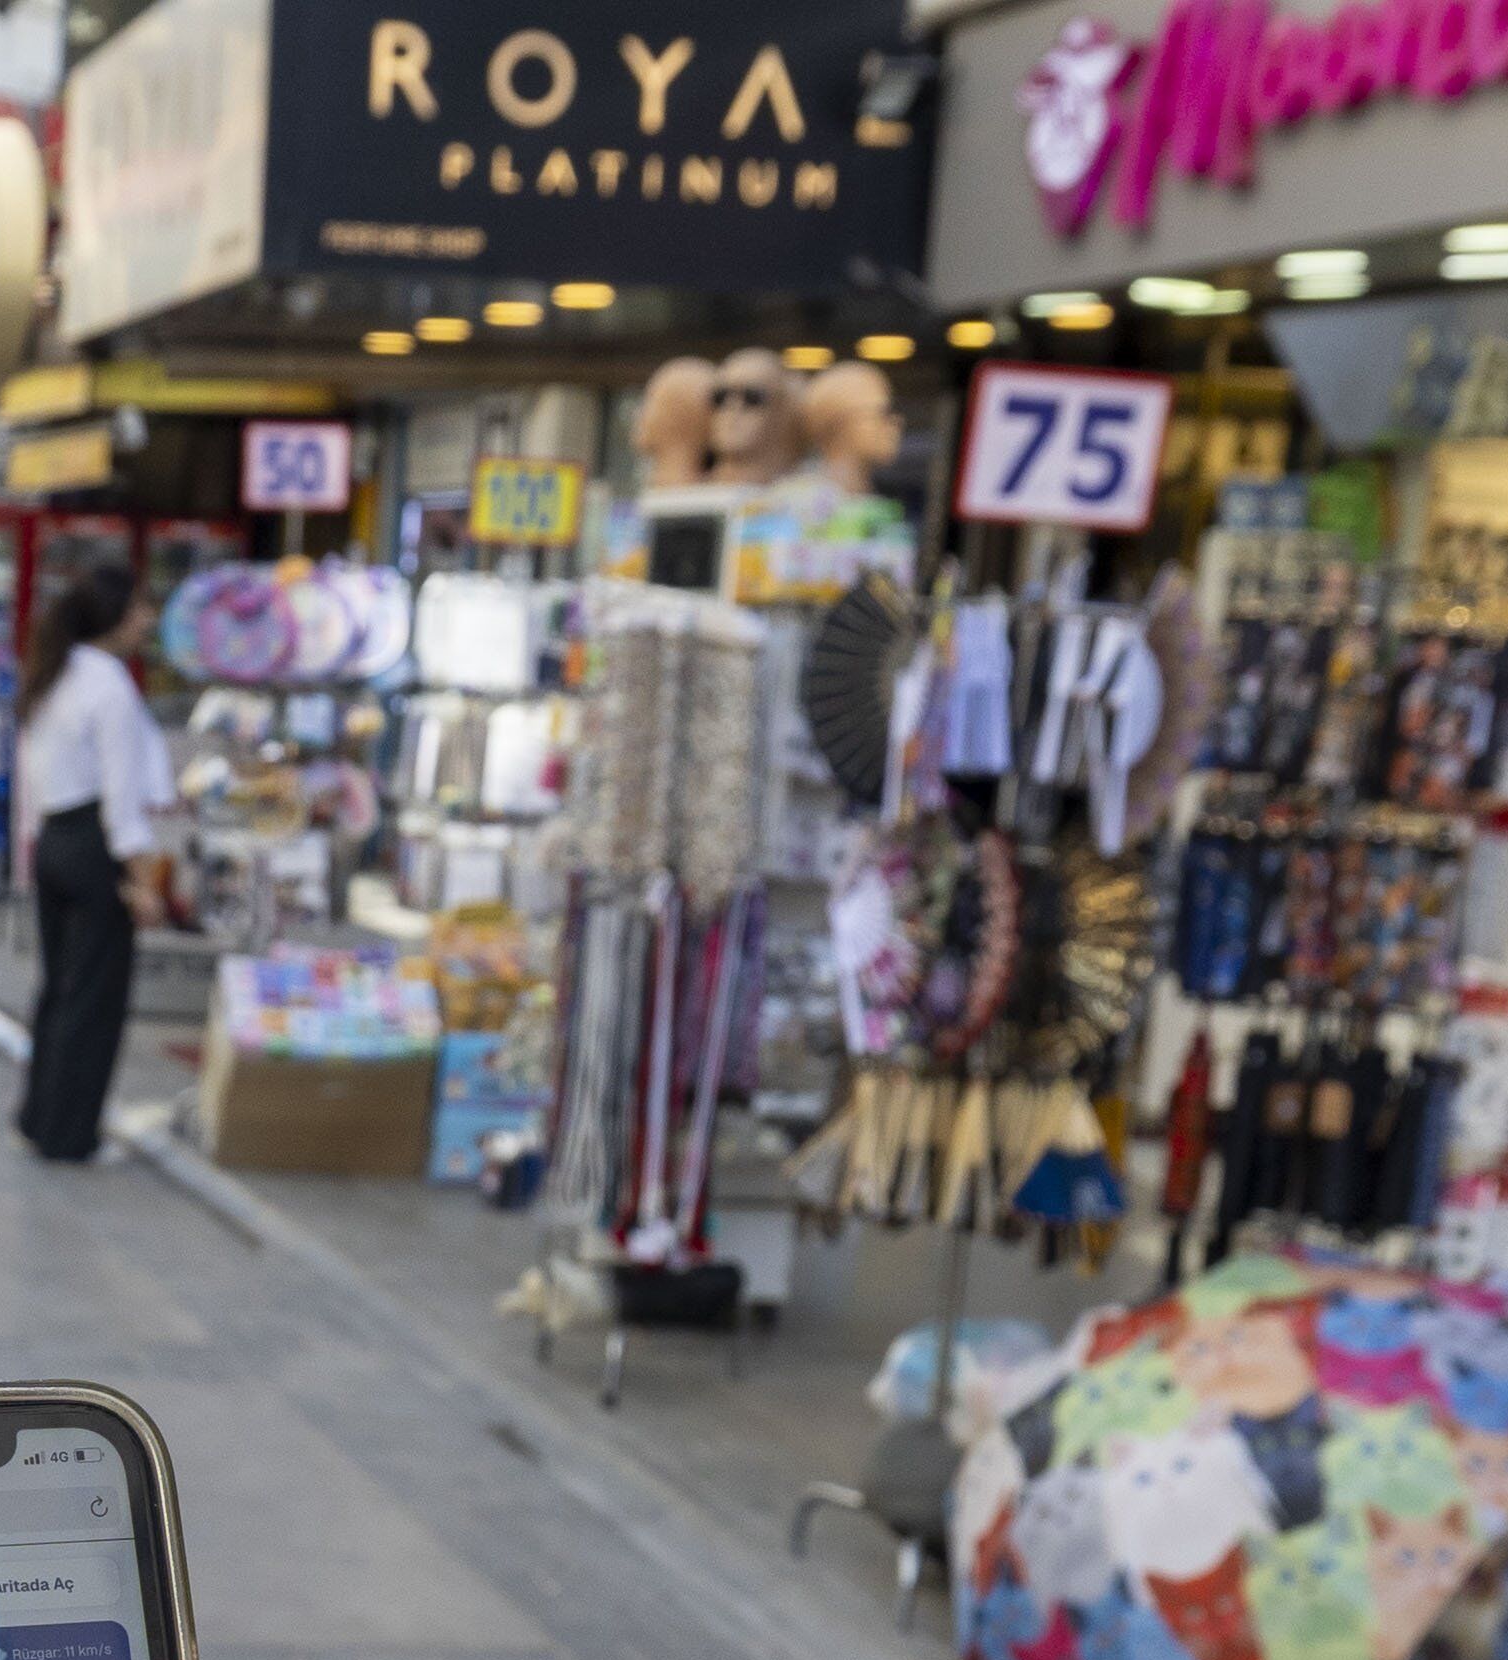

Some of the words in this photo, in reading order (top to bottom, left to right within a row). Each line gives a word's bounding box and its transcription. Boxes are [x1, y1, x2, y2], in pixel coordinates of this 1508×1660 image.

[439, 141, 839, 210] PLATINUM
[262, 438, 329, 494] 50
[1001, 394, 1135, 503] 75
[49, 1450, 70, 1464] 4G
[54, 1576, 75, 1594] Aç
[12, 1647, 61, 1660] Rüzgar:
[64, 1646, 76, 1658] 11
[78, 1643, 112, 1657] km/s
